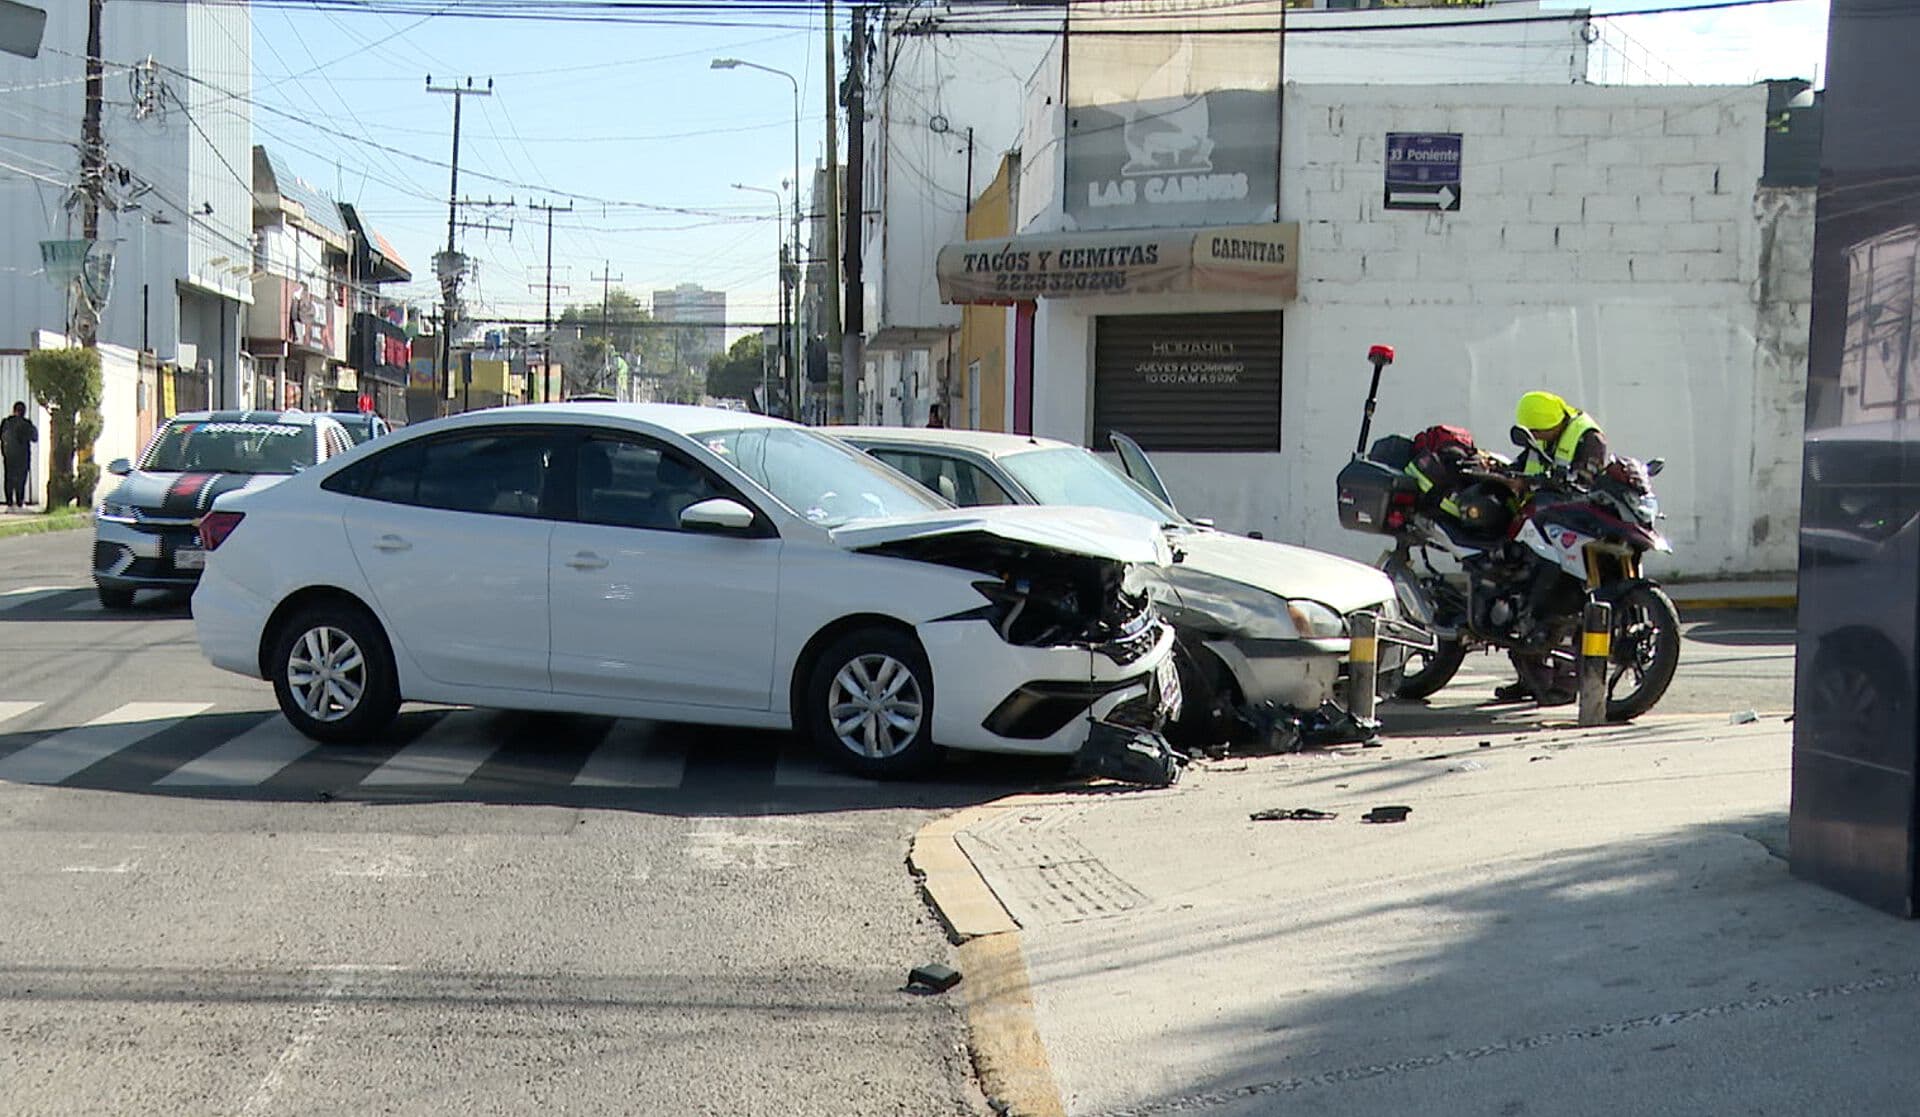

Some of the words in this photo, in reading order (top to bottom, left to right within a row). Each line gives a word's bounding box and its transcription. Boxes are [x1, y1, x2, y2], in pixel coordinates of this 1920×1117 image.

[1408, 149, 1458, 160] Poniente
[1088, 180, 1137, 207] LAS
[1037, 251, 1051, 271] Y
[1058, 244, 1158, 269] CEMITAS
[1211, 237, 1285, 264] CARNITAS
